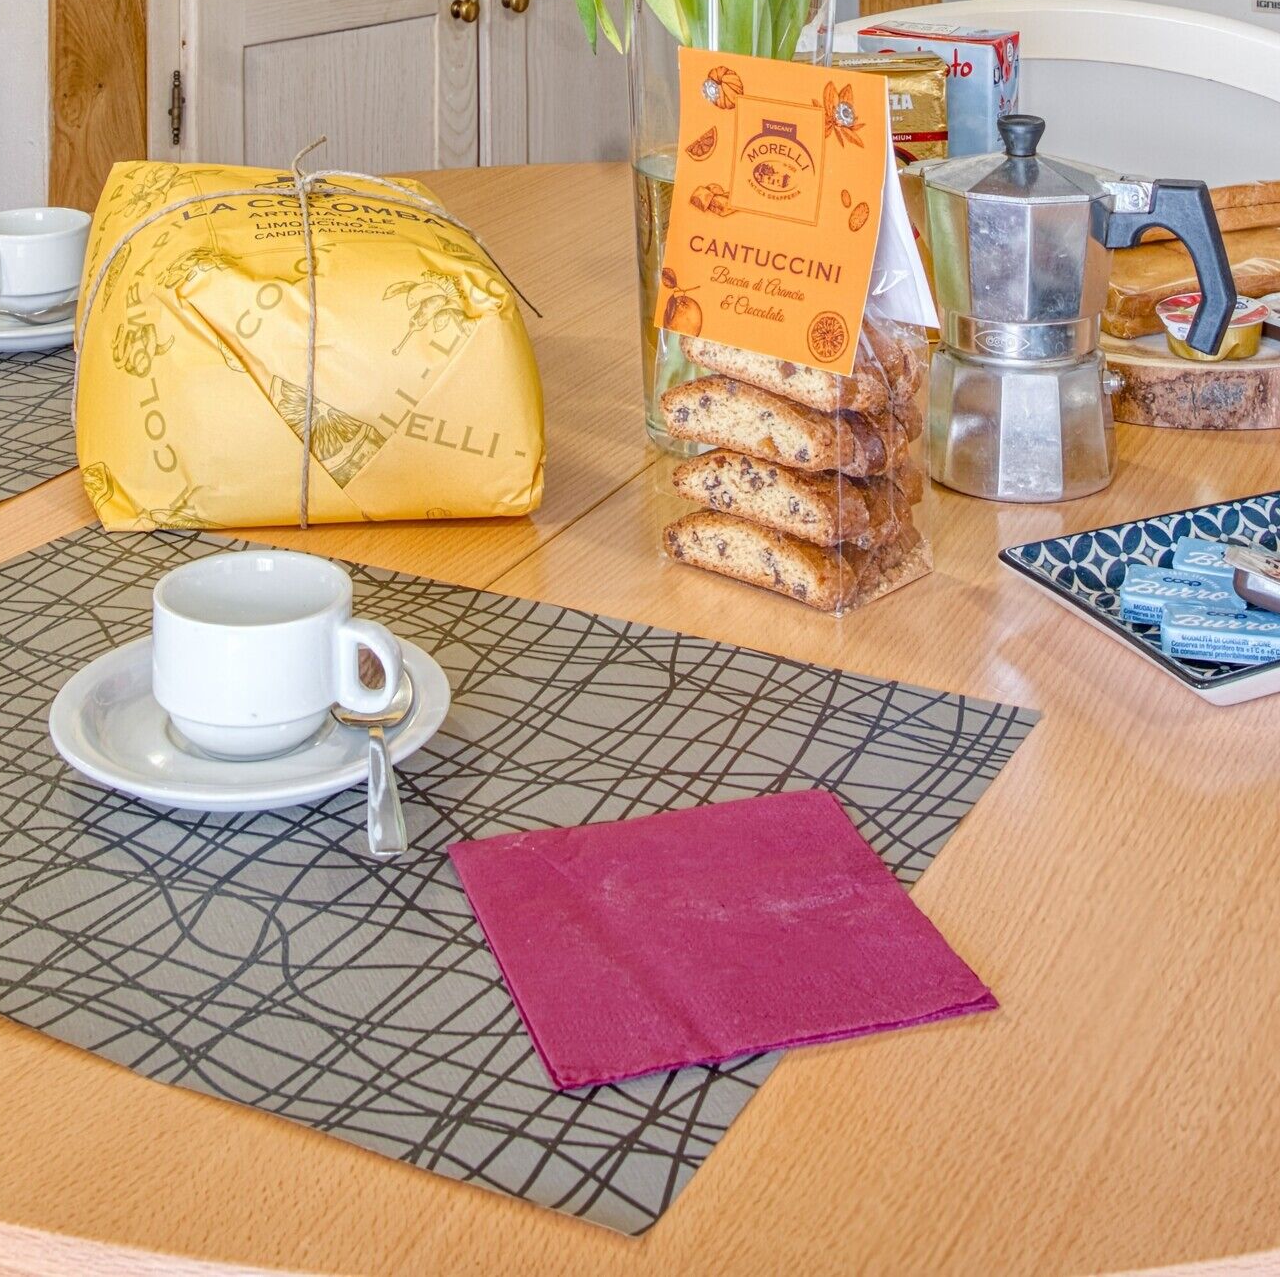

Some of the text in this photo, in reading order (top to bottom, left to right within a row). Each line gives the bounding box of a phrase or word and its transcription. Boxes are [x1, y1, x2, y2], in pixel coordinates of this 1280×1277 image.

[747, 143, 810, 171] MORELLI
[182, 203, 236, 221] LA
[689, 235, 842, 284] CANTUCCINI
[710, 265, 805, 302] Buccia di Arancio
[720, 294, 786, 323] & Cioccolato
[1124, 578, 1233, 601] Burro
[1162, 576, 1202, 588] coop
[1206, 611, 1248, 620] coop
[1170, 640, 1198, 649] Conserva
